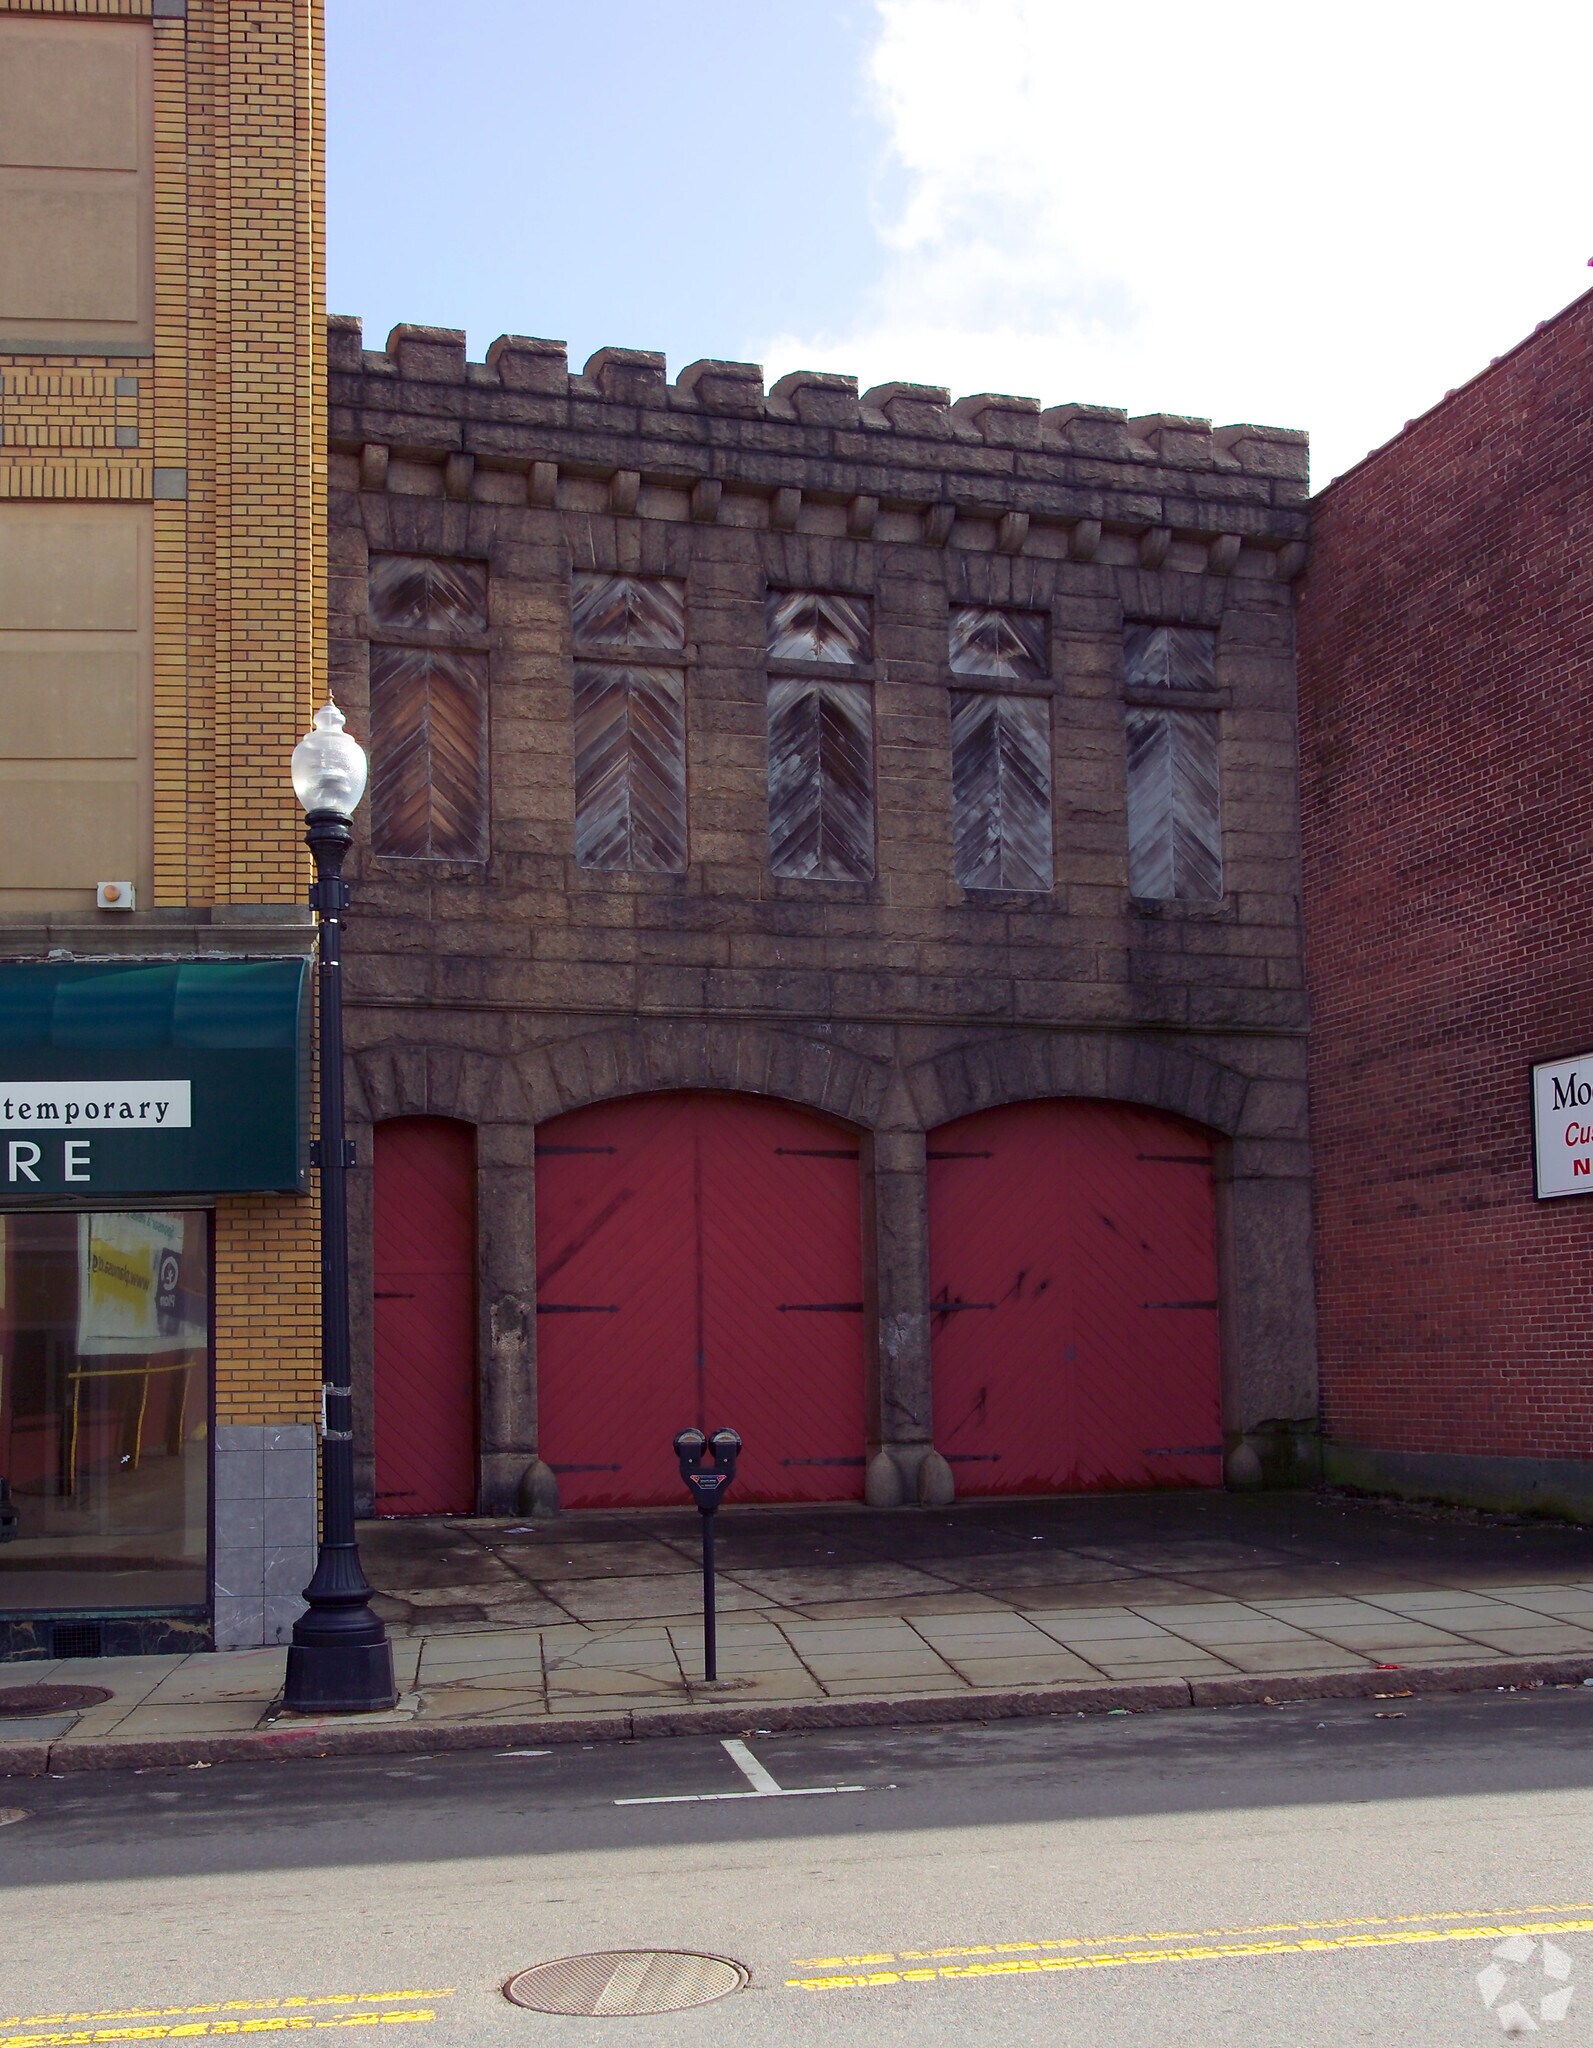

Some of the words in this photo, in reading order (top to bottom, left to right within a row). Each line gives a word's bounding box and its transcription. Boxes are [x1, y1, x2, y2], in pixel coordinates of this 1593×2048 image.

[1552, 1072, 1593, 1111] Mo
[3, 1097, 170, 1124] temporary
[1565, 1121, 1593, 1147] Cu
[8, 1140, 91, 1182] RE
